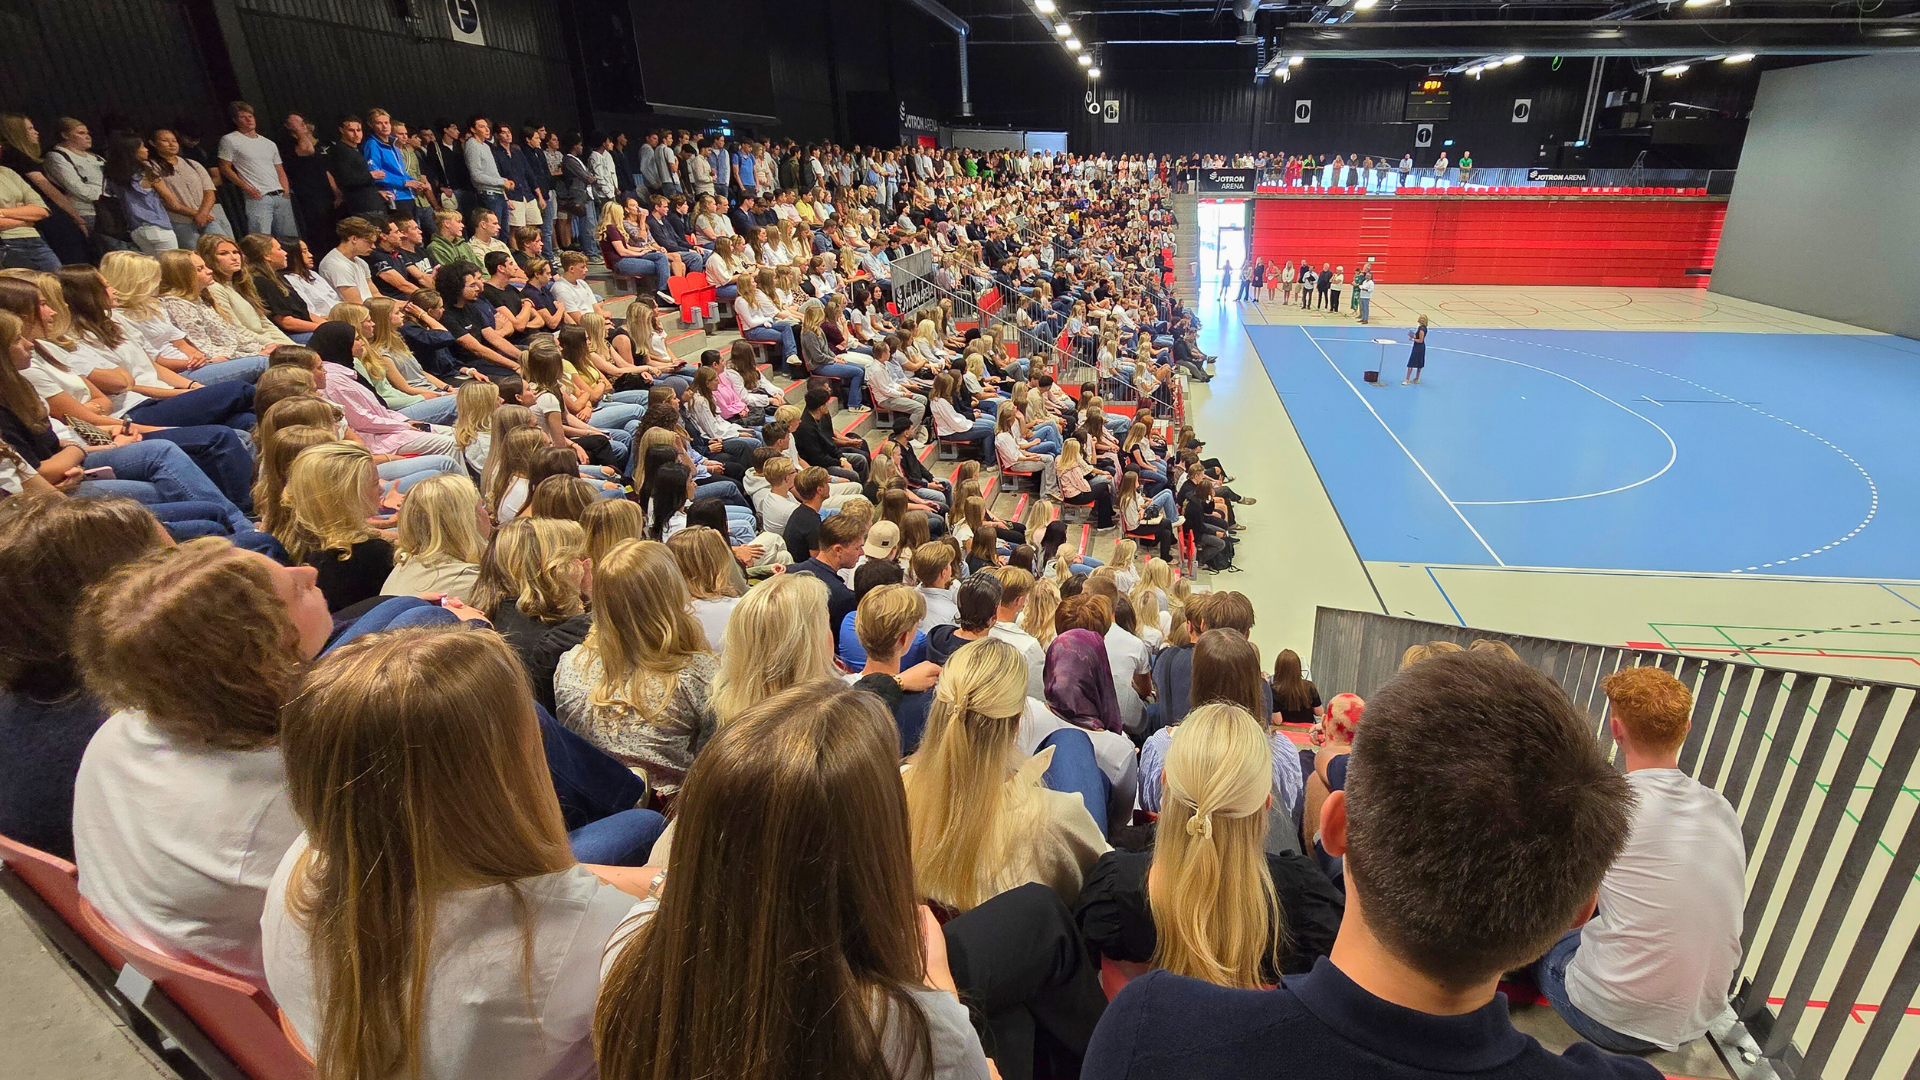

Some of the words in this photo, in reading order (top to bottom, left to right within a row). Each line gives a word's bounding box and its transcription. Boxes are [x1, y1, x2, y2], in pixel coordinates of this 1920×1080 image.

[455, 0, 470, 29] F
[1108, 106, 1116, 118] H
[905, 114, 924, 130] JOTRON
[925, 118, 938, 132] ARENA
[1421, 130, 1427, 142] 1
